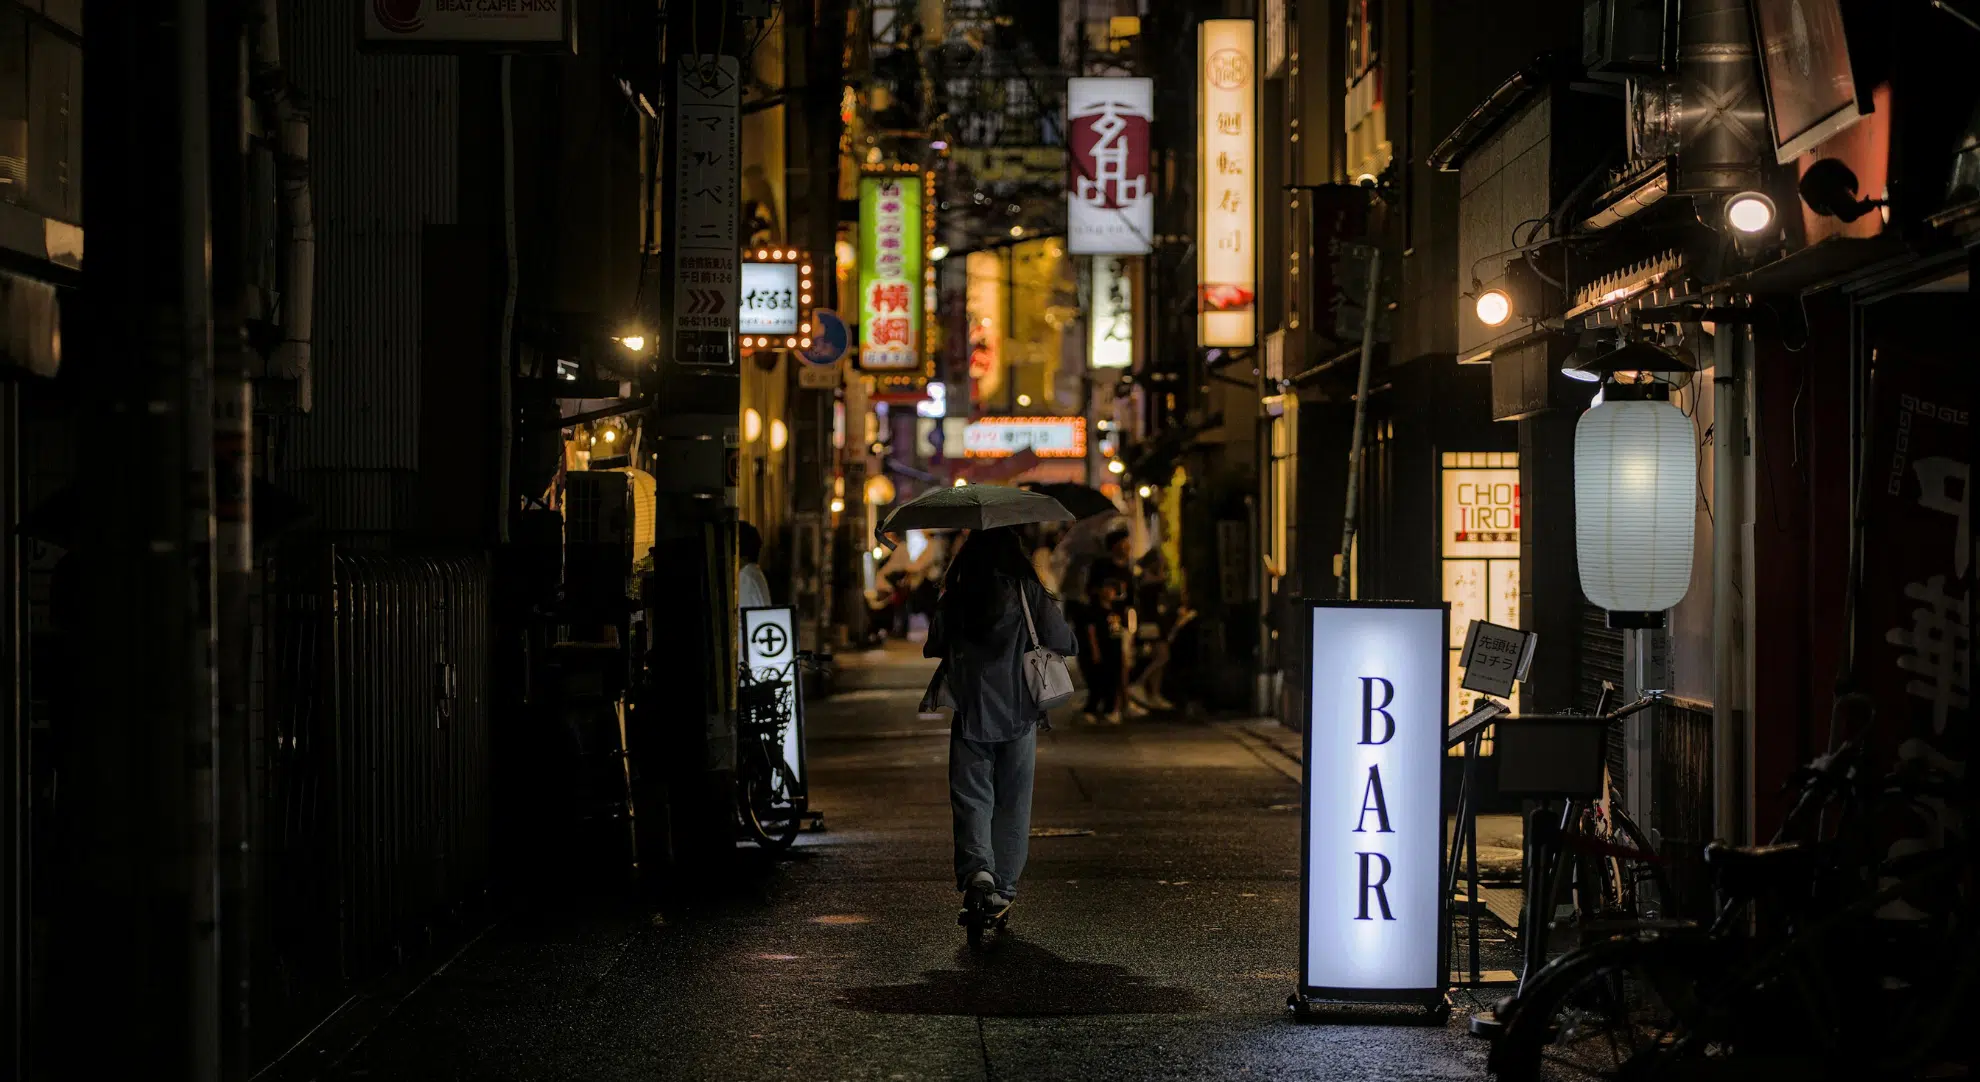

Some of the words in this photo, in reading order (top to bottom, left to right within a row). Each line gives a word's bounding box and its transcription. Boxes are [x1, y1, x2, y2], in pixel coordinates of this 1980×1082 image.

[436, 0, 472, 11] BEAT
[476, 0, 517, 11] CAFE
[521, 0, 557, 11] MIXX
[693, 115, 722, 239] マルベニ
[872, 284, 909, 346] 横綱
[1458, 483, 1511, 505] CHO
[1479, 635, 1519, 655] 先頭は
[1475, 653, 1513, 671] コチラ
[1352, 676, 1397, 921] BAR
